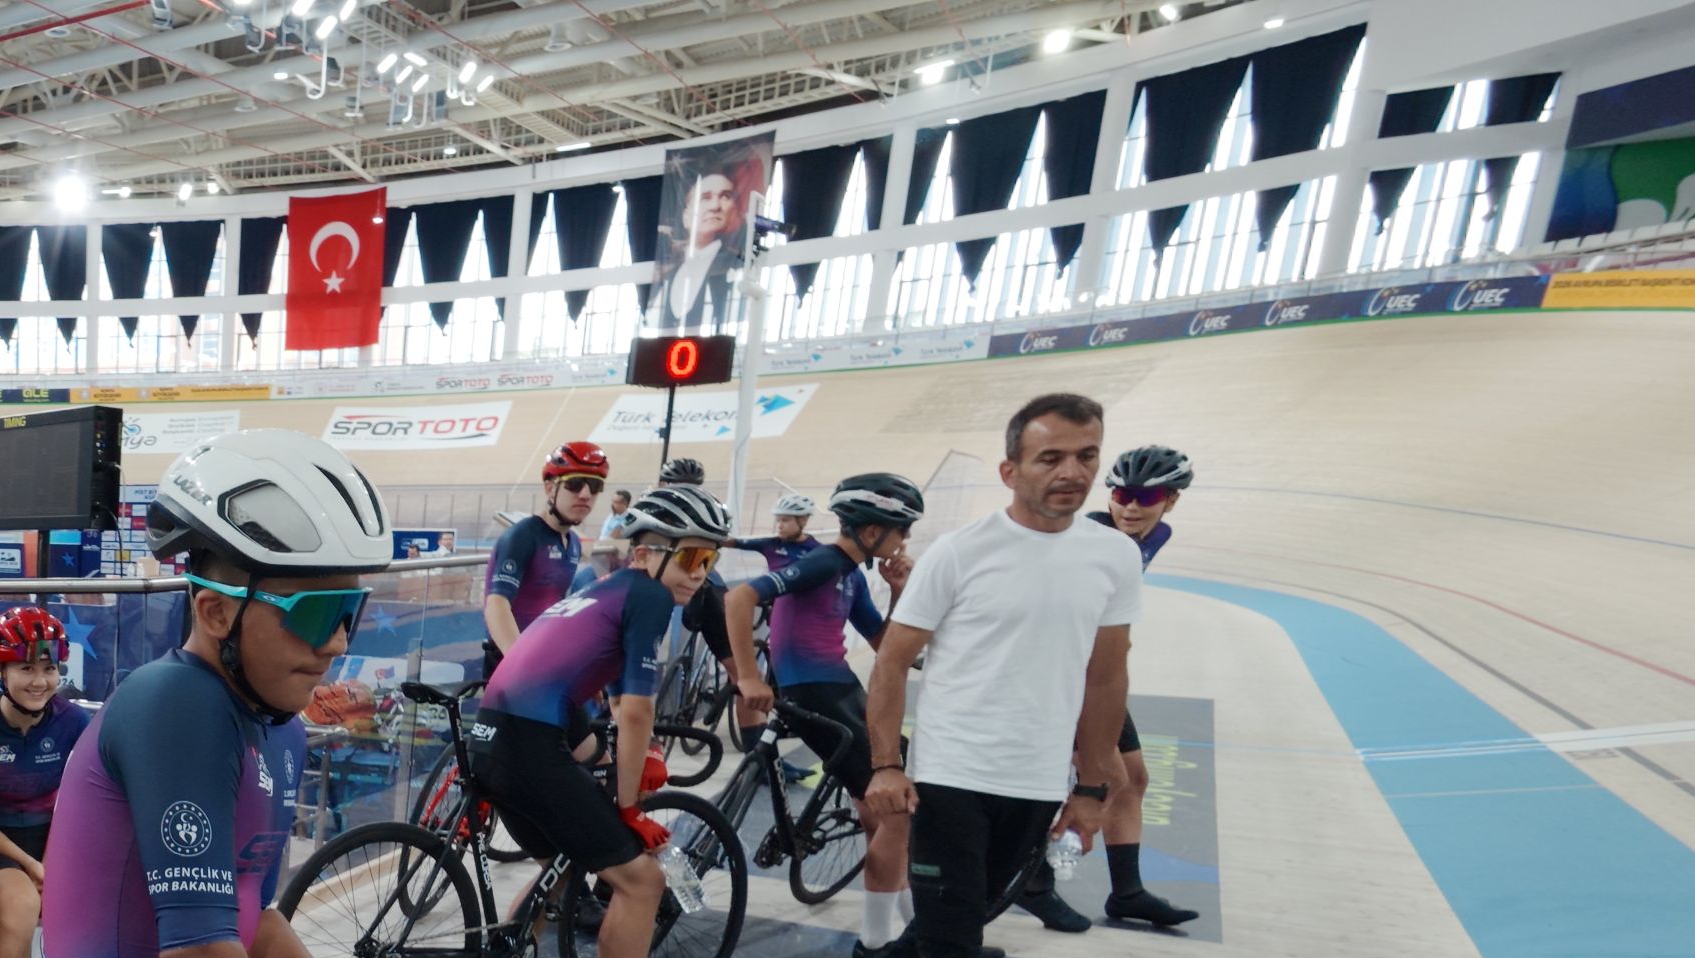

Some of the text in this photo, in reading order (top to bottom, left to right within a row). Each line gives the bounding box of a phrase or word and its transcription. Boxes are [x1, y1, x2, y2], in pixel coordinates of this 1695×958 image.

[668, 338, 697, 377] 0
[612, 408, 739, 423] Türk eleko
[173, 475, 213, 505] LAZER
[471, 722, 497, 741] SEM
[147, 866, 233, 882] T.C. GENÇLİK VE
[148, 881, 234, 895] SPOR BAKANLIĞI
